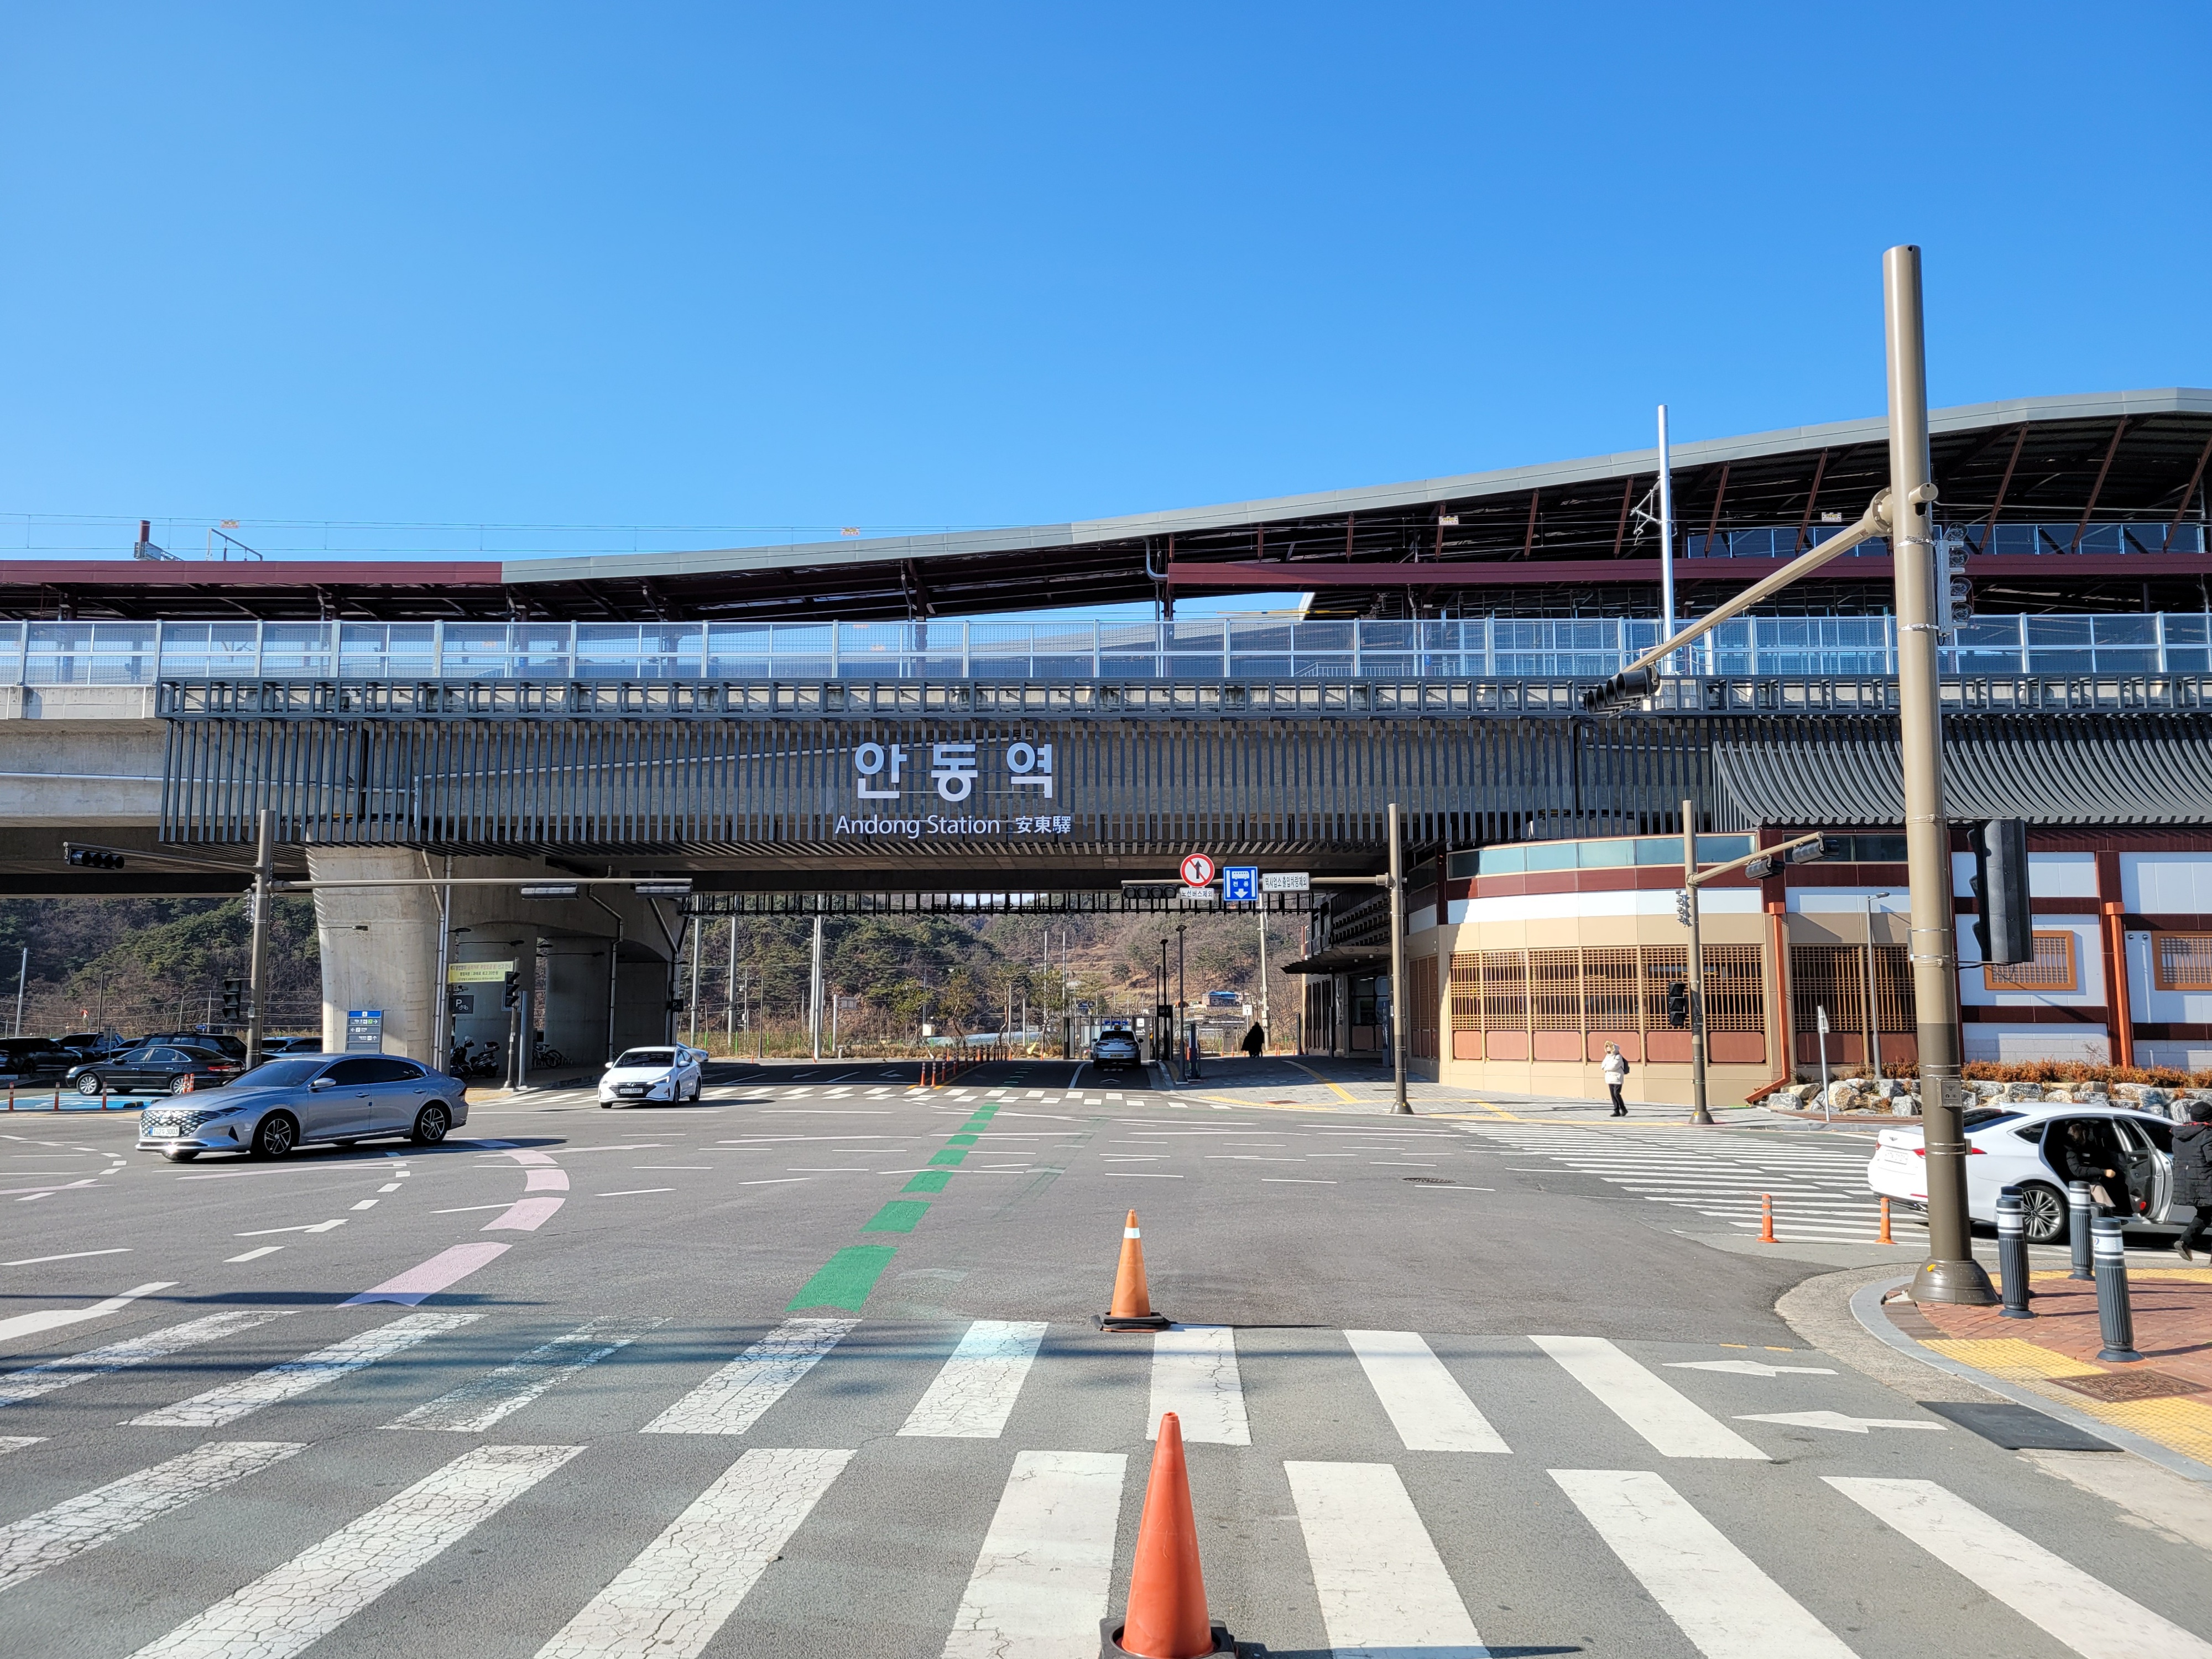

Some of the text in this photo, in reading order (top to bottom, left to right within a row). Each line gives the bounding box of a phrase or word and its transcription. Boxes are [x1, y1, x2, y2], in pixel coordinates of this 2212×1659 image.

[834, 815, 1000, 839] Andong Station
[1015, 816, 1071, 834] 安東驛
[456, 999, 462, 1007] P
